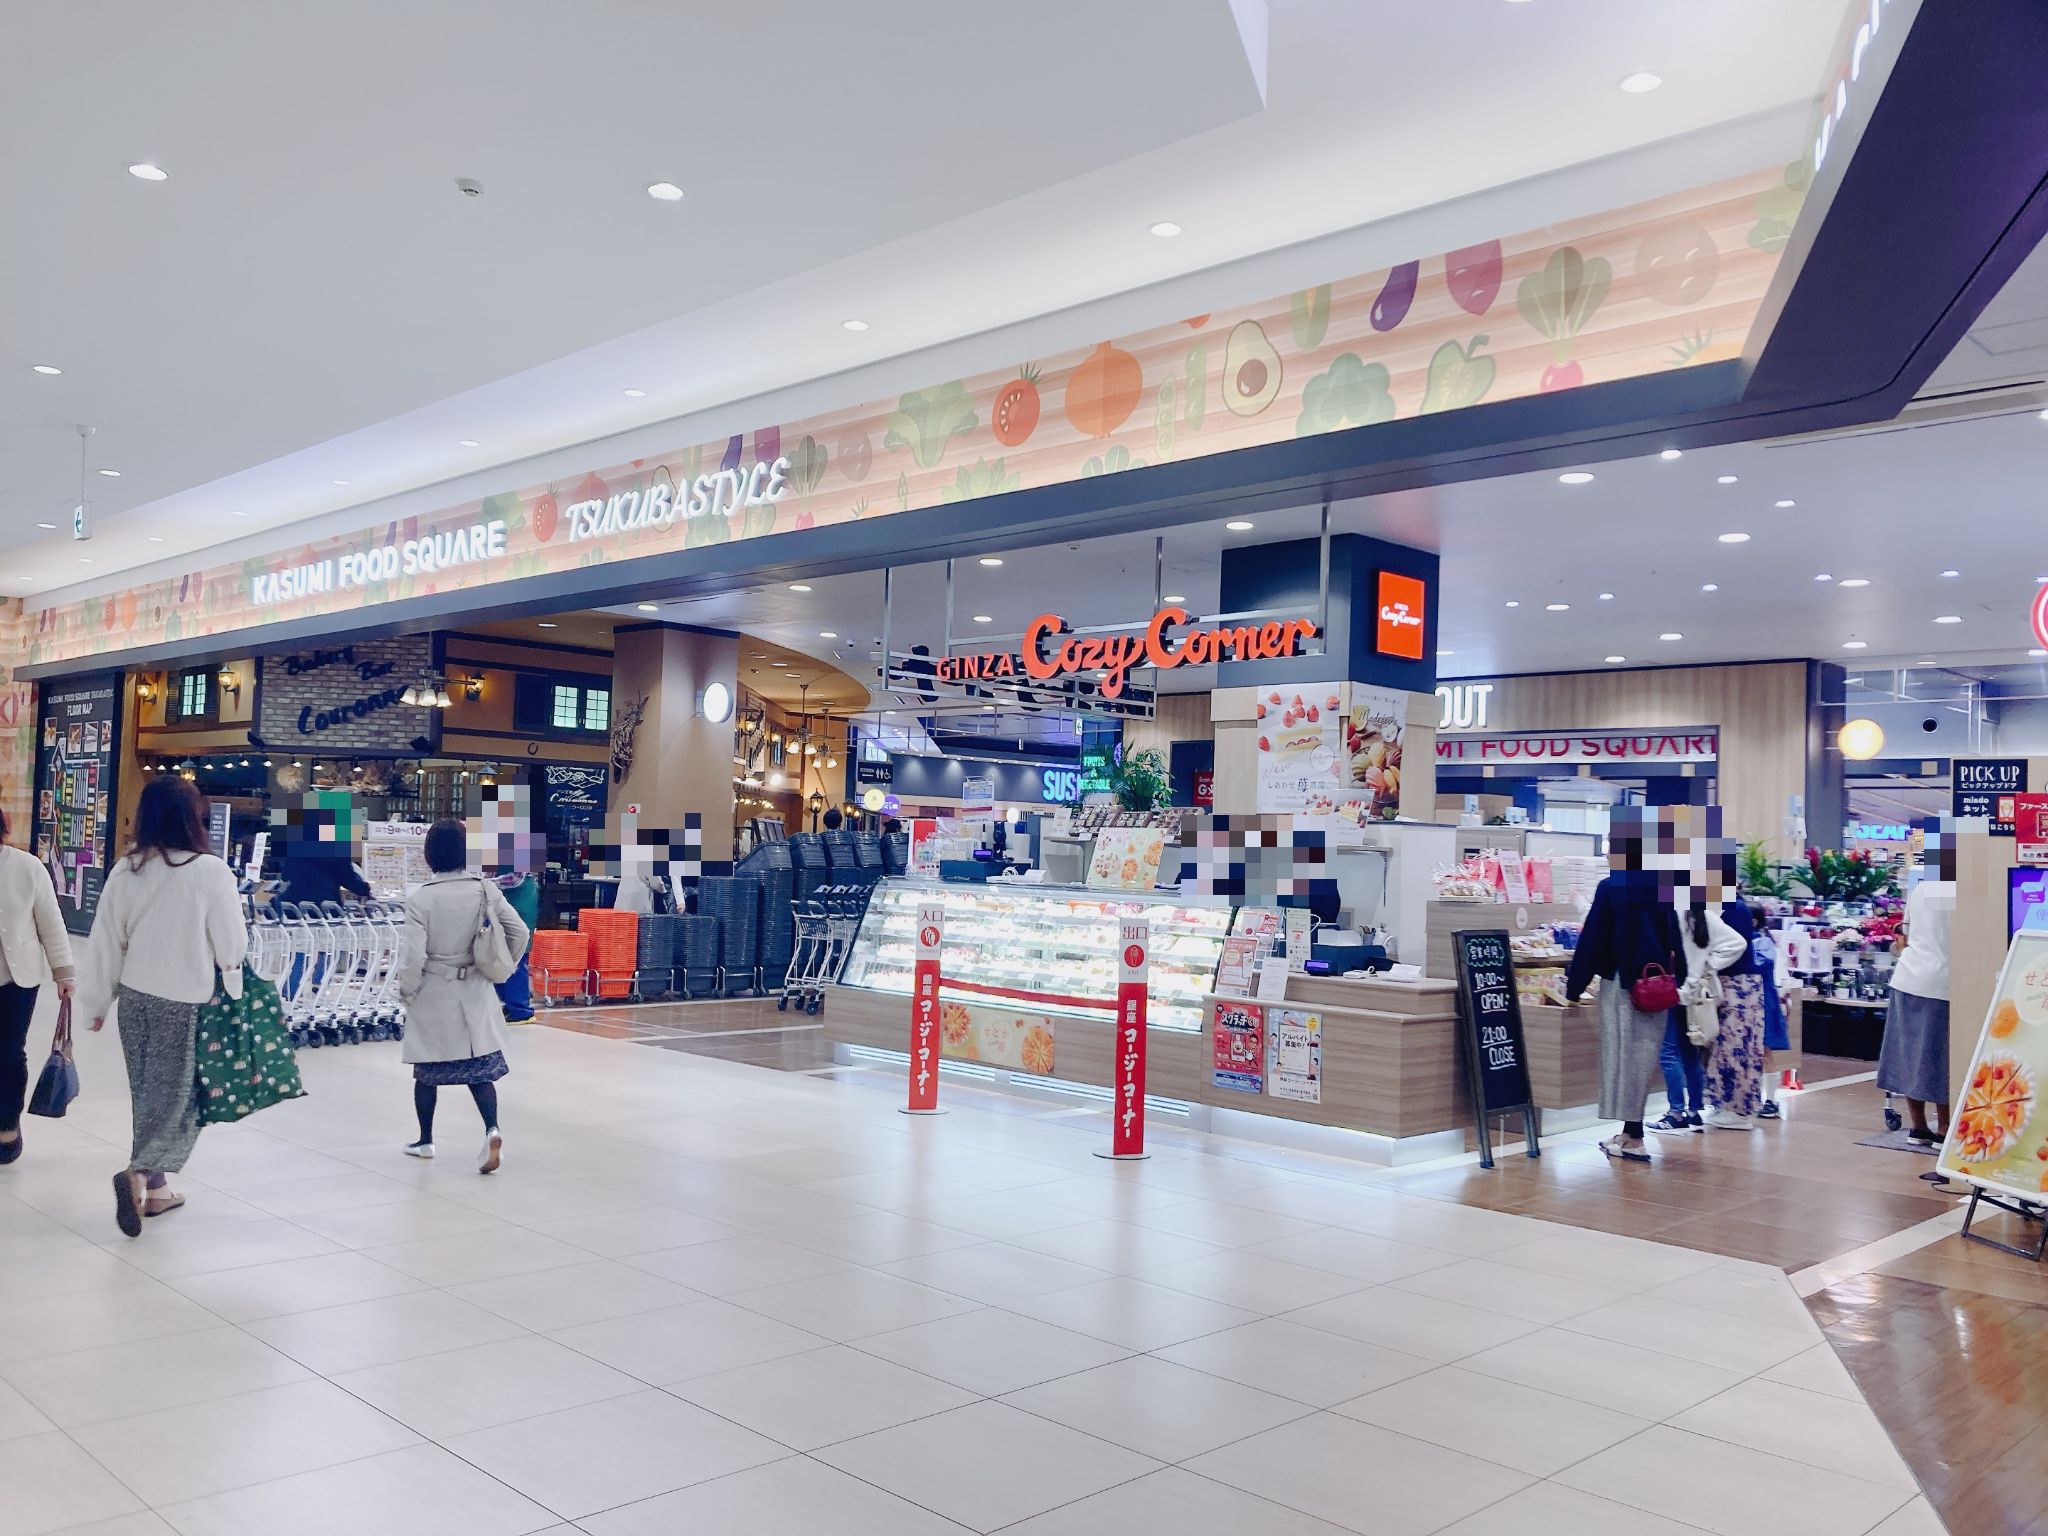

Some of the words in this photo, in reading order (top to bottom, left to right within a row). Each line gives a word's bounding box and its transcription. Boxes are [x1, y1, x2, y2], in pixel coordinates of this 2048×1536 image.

[565, 456, 792, 542] TSUKUBASTYLE
[252, 559, 331, 605] KASUMI
[338, 545, 399, 587] FOOD
[402, 519, 507, 575] SQUARE
[937, 652, 1014, 681] GINZA
[1022, 614, 1147, 698] Cozy
[1146, 607, 1318, 670] Corner
[82, 702, 93, 715] MAP
[1481, 737, 1570, 758] FOOD
[1960, 766, 1996, 782] PICK
[2000, 766, 2020, 782] UP
[1042, 769, 1081, 801] SUS
[1963, 796, 1990, 804] misdo
[1963, 805, 1988, 813] ネット
[920, 909, 943, 922] 入口
[1123, 925, 1147, 940] 出口
[1281, 1032, 1309, 1042] アルバイト
[1482, 1025, 1508, 1044] 21:00
[917, 999, 934, 1096] コージーコーナー
[1488, 1045, 1516, 1066] CLOSE
[1122, 1027, 1139, 1138] コージーコーナー
